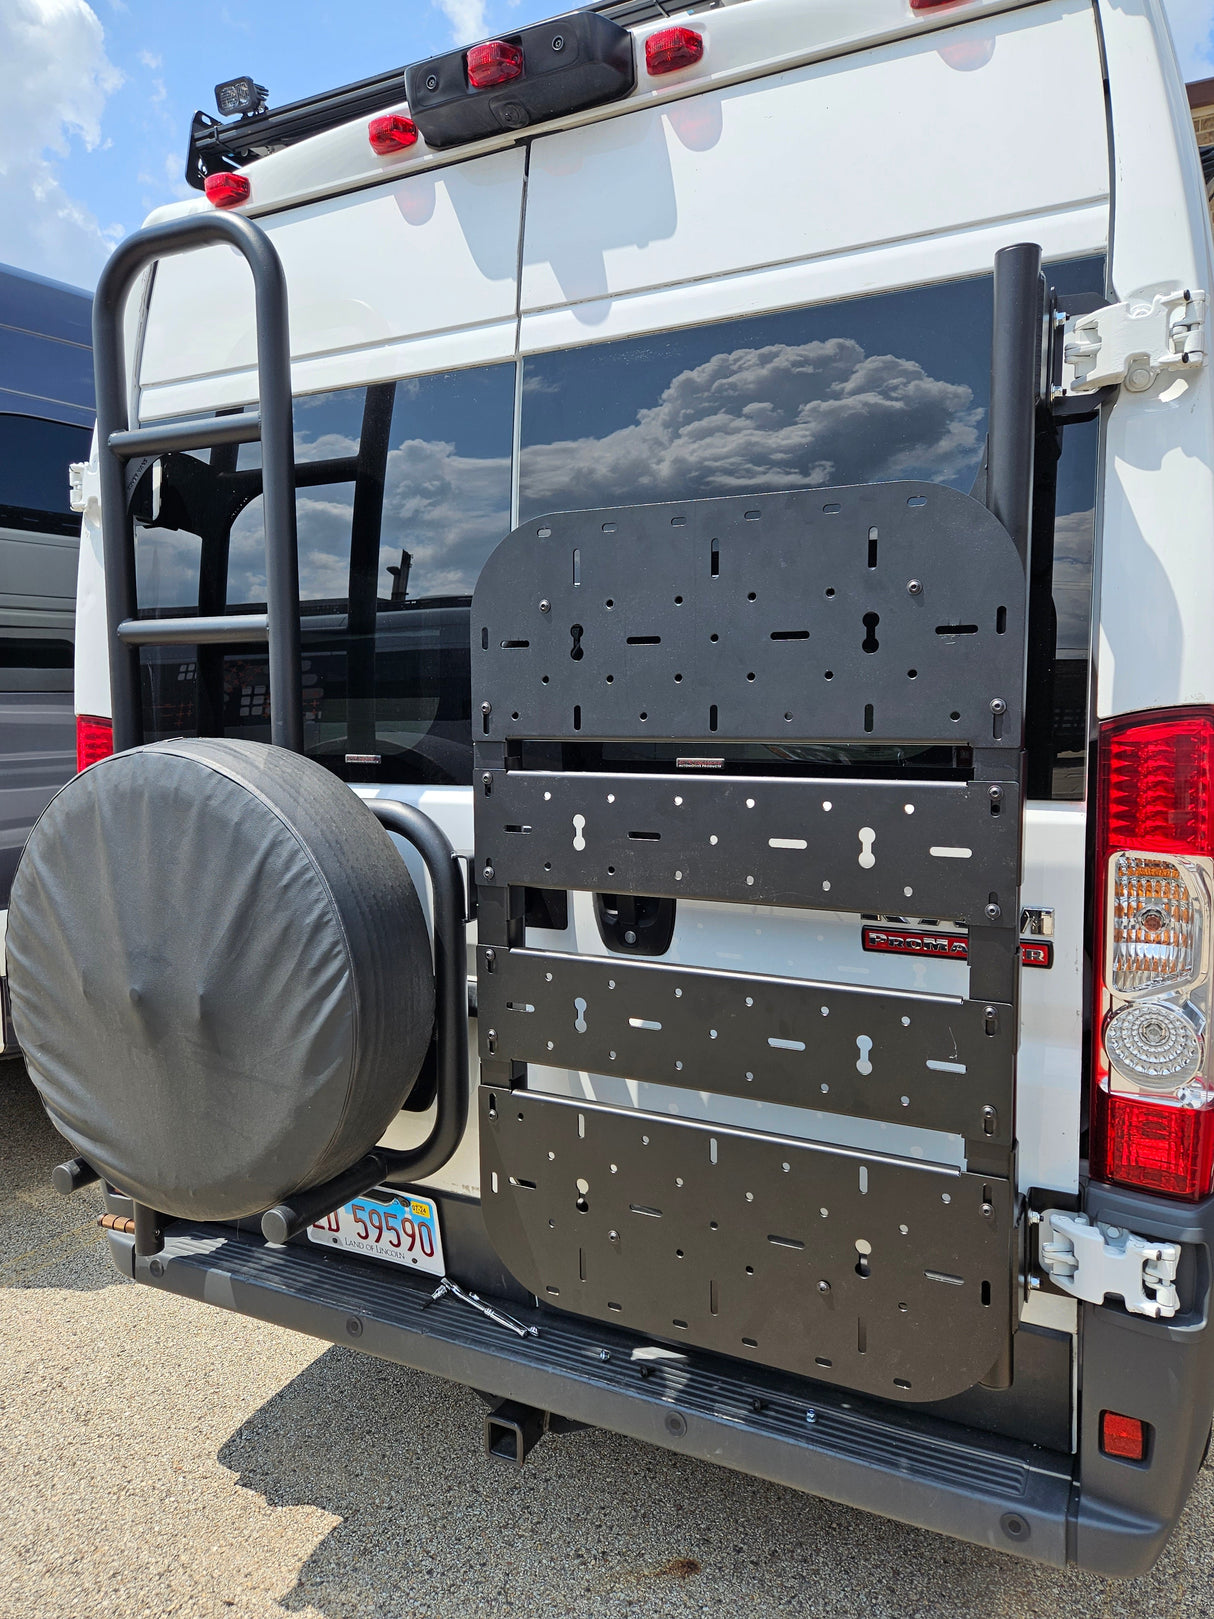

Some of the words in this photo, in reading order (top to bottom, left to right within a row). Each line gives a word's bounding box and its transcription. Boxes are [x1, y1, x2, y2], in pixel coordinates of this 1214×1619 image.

[345, 1237, 364, 1249] LAND
[376, 1245, 405, 1259] LINCOLN
[352, 1204, 434, 1257] 59590
